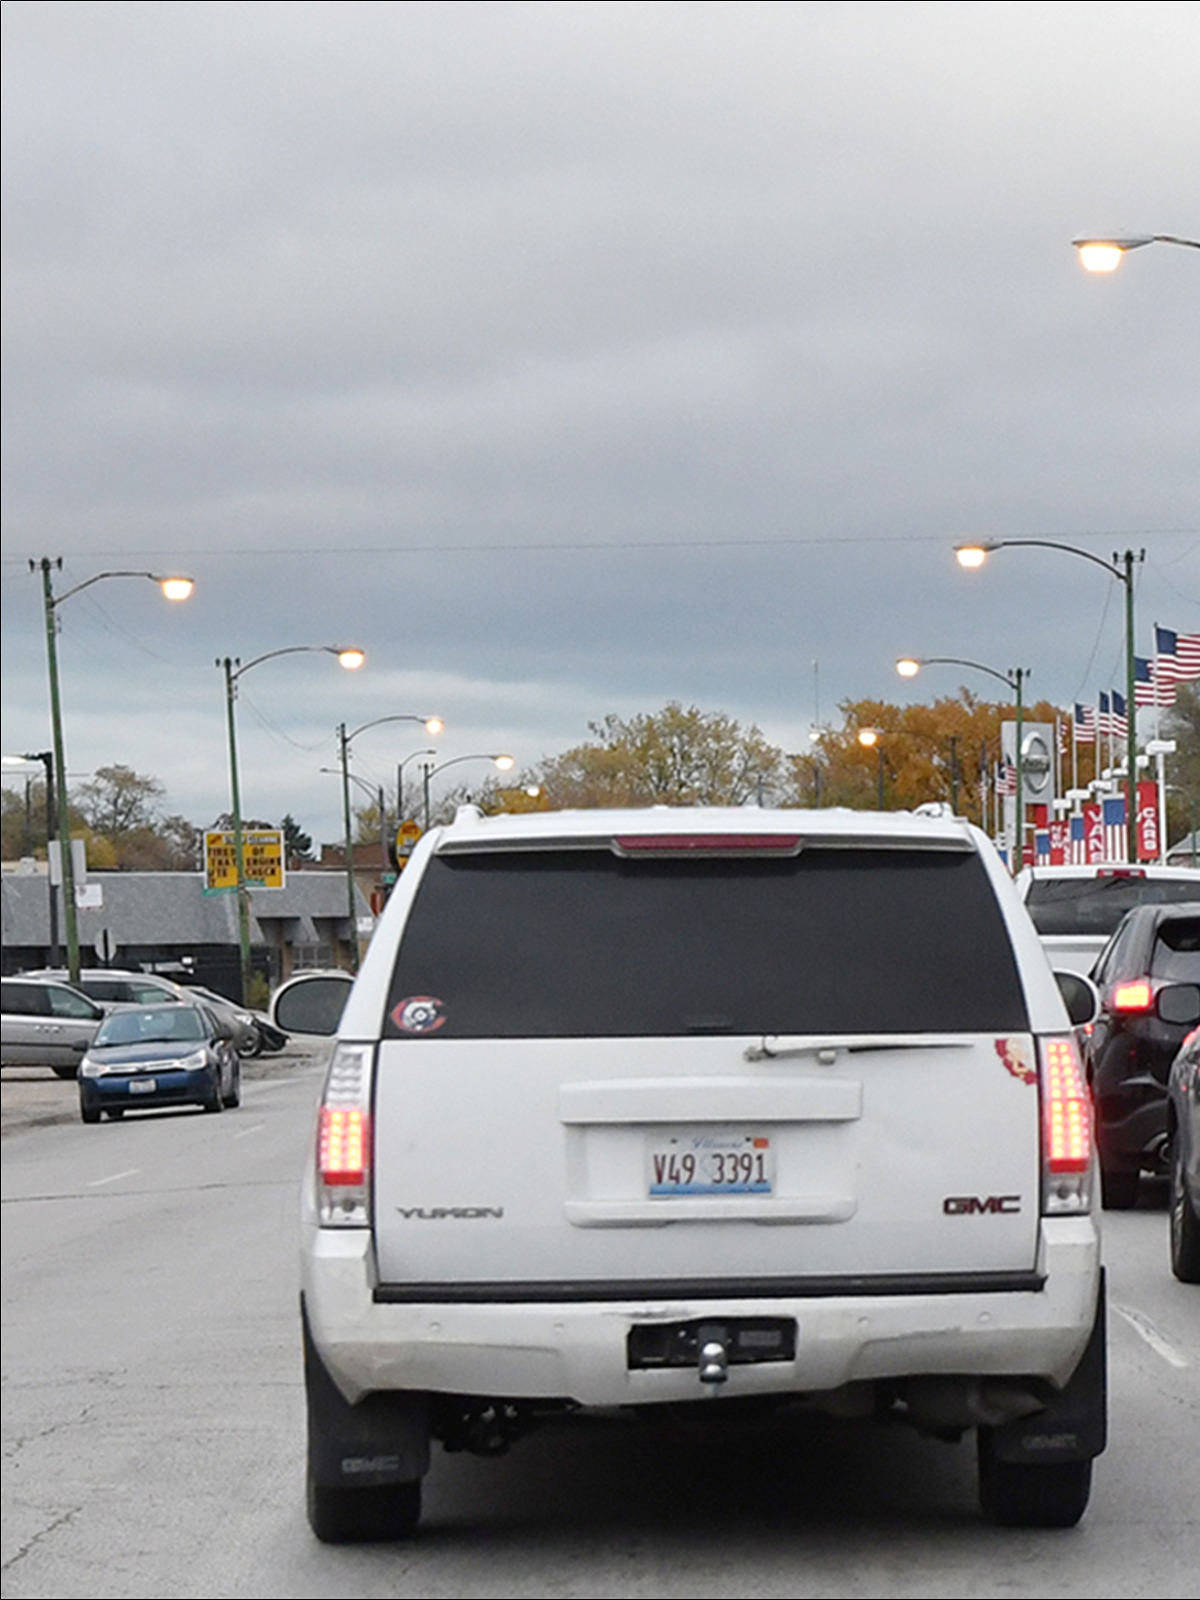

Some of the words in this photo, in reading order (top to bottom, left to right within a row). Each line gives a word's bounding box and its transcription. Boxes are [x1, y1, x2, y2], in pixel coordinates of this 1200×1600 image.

[1142, 807, 1157, 850] CARS
[653, 1153, 696, 1185] V49
[712, 1153, 768, 1184] 3391
[396, 1206, 504, 1219] YUKON
[943, 1195, 1021, 1215] GMC
